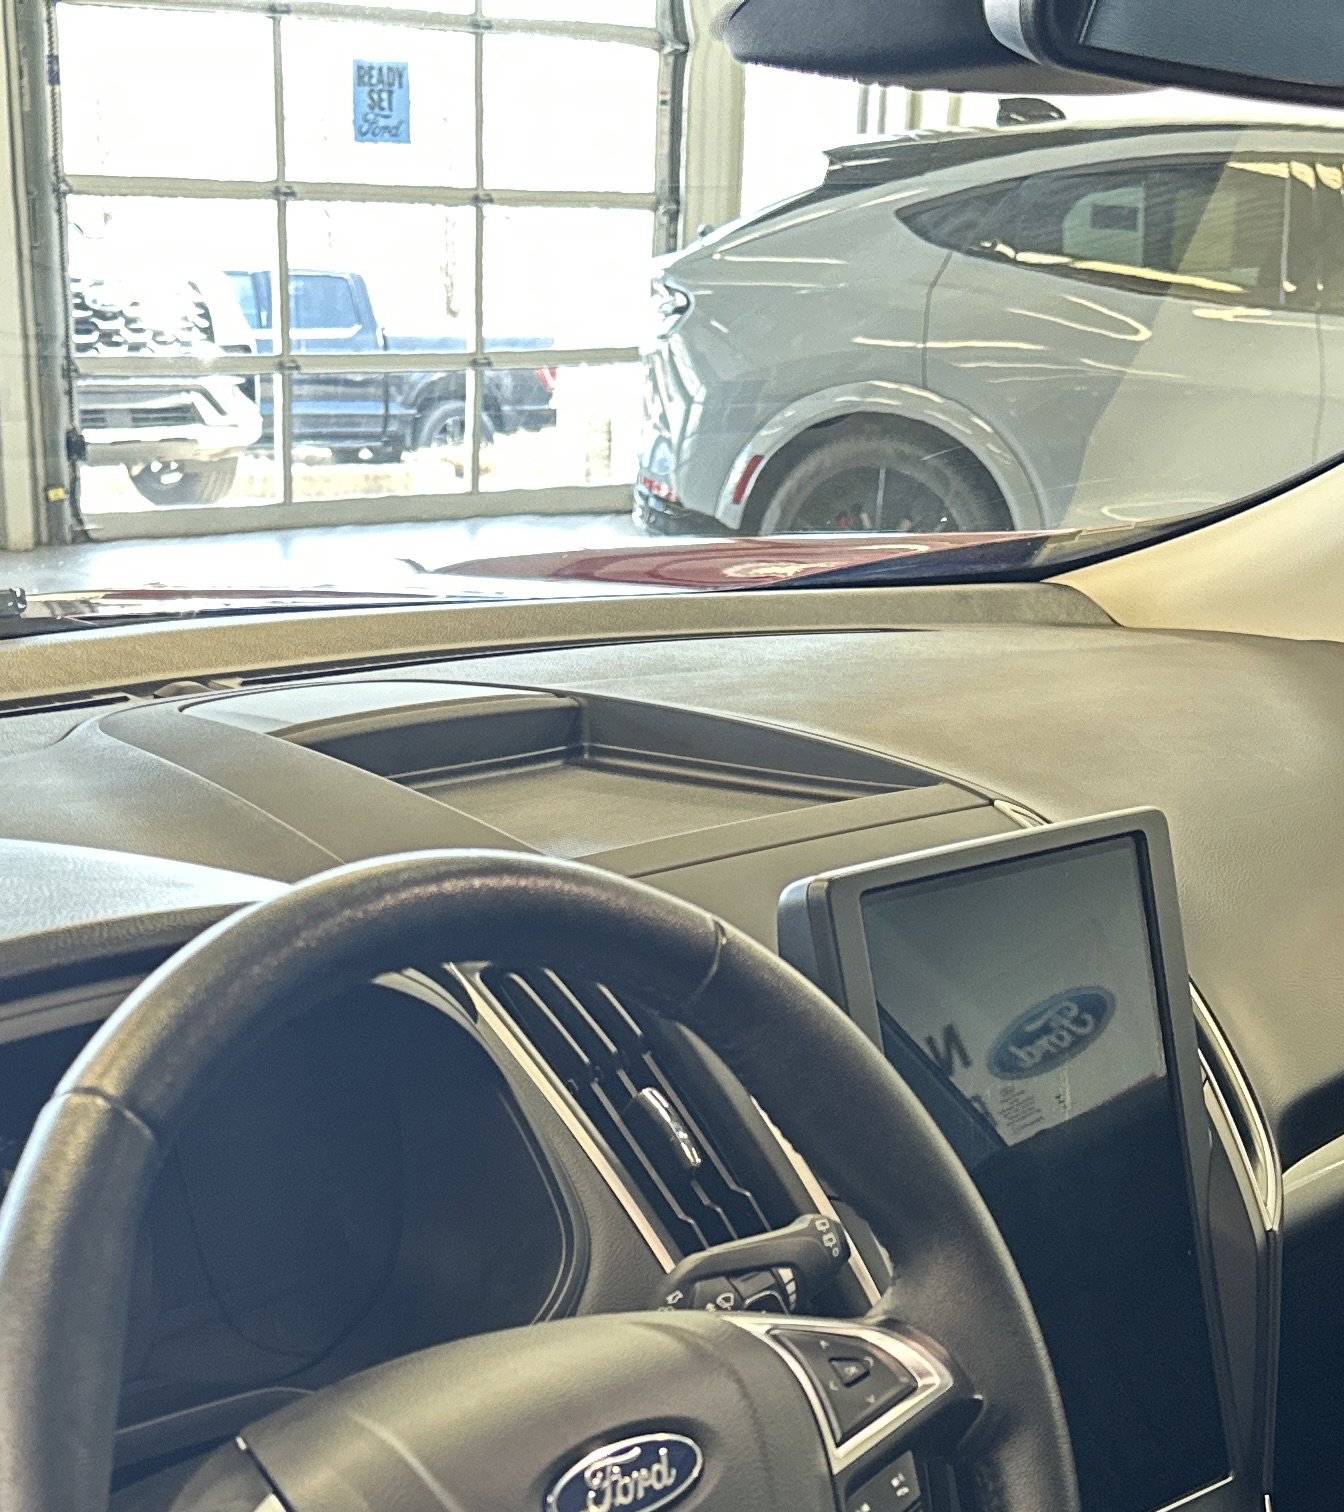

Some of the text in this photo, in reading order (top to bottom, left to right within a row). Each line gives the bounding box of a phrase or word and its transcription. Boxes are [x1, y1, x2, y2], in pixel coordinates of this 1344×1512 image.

[357, 65, 404, 88] READY
[368, 88, 393, 112] SET
[358, 112, 404, 137] Ford
